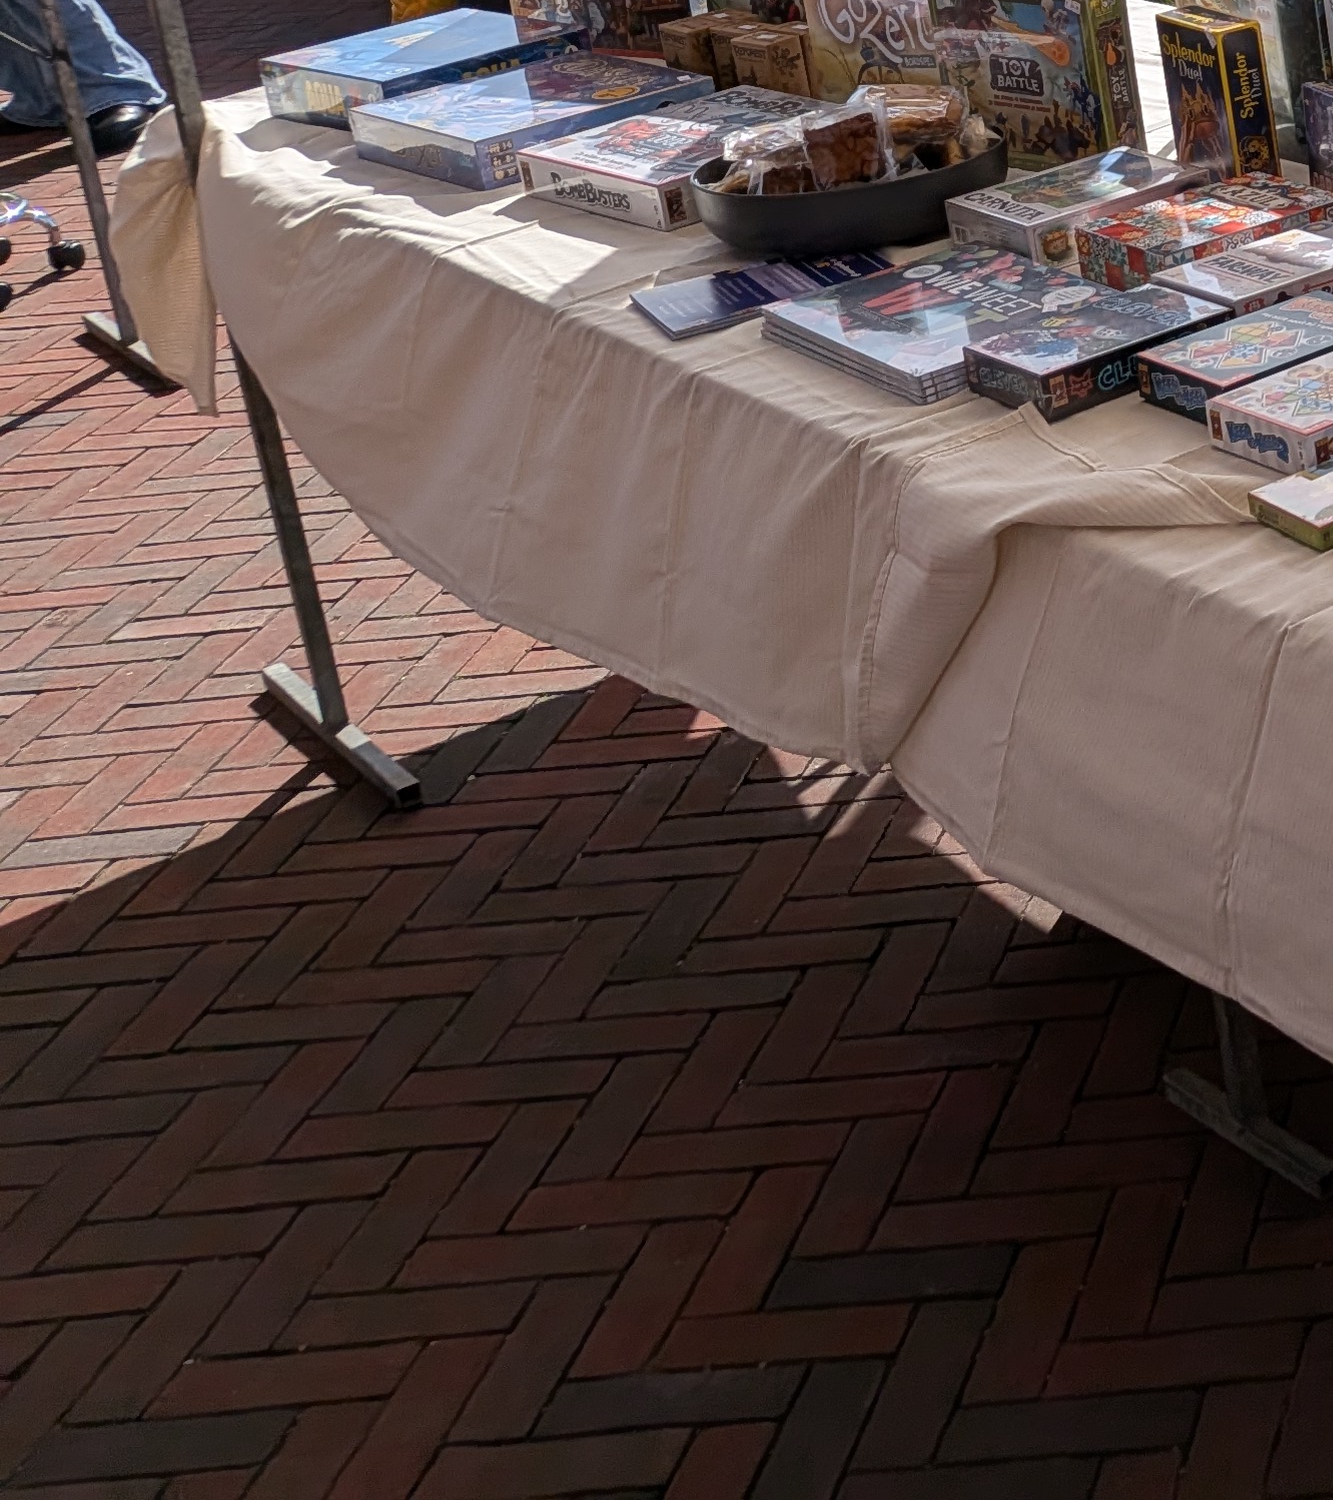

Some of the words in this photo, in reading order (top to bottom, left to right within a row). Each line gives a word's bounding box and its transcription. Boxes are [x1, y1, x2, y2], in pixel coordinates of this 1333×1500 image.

[1161, 31, 1216, 69] Splendor
[999, 59, 1032, 78] TOY
[1178, 57, 1204, 82] Duel
[1249, 66, 1262, 101] Duel
[997, 75, 1041, 94] BATTLE
[1112, 76, 1123, 102] TOY
[1234, 51, 1256, 120] Splendor
[963, 191, 1046, 221] CARNUTA
[1202, 254, 1284, 284] FARAWAY
[925, 271, 984, 296] WIE
[963, 285, 1043, 317] WEET
